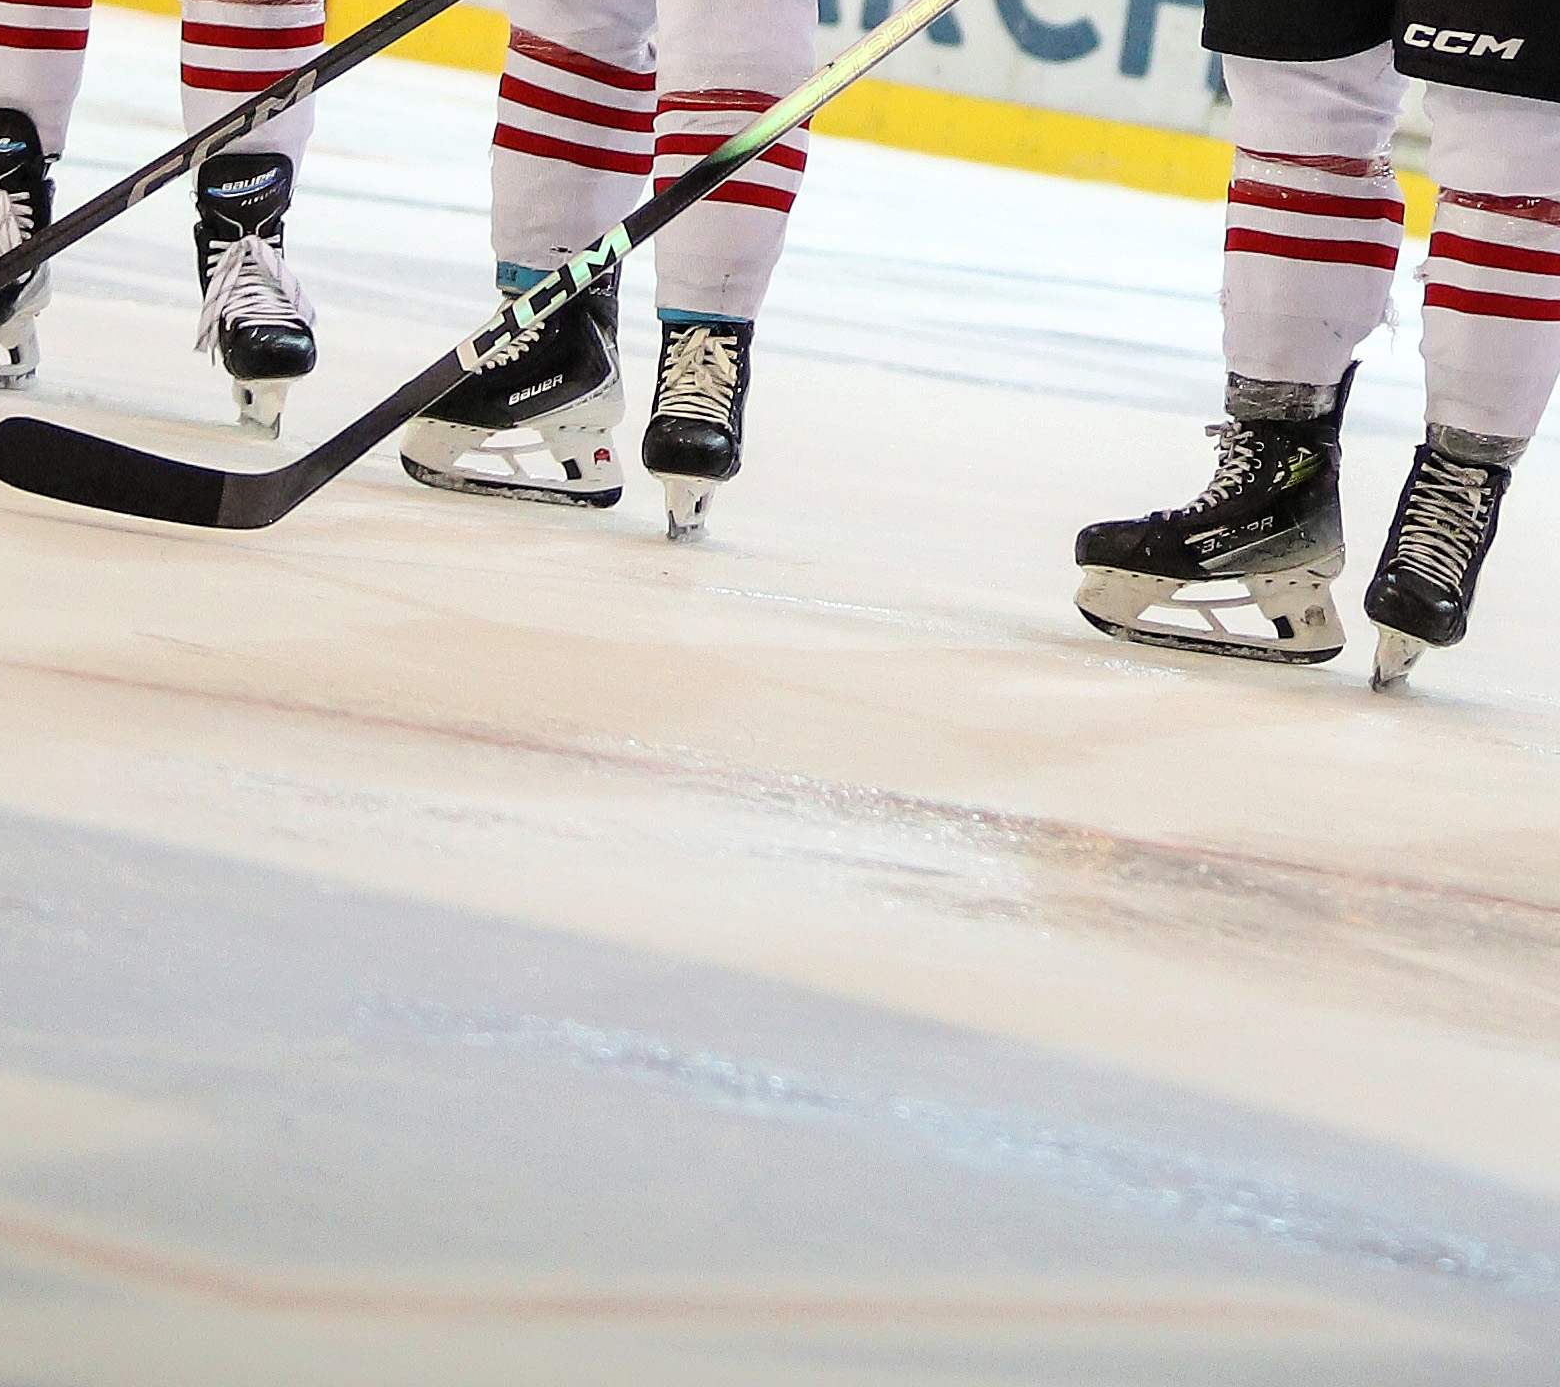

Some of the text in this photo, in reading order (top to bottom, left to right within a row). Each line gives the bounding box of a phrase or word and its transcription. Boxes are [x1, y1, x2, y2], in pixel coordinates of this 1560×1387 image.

[1403, 23, 1525, 61] CCM
[221, 167, 277, 193] BAUER
[456, 221, 632, 374] CCM
[508, 372, 564, 408] BAUER
